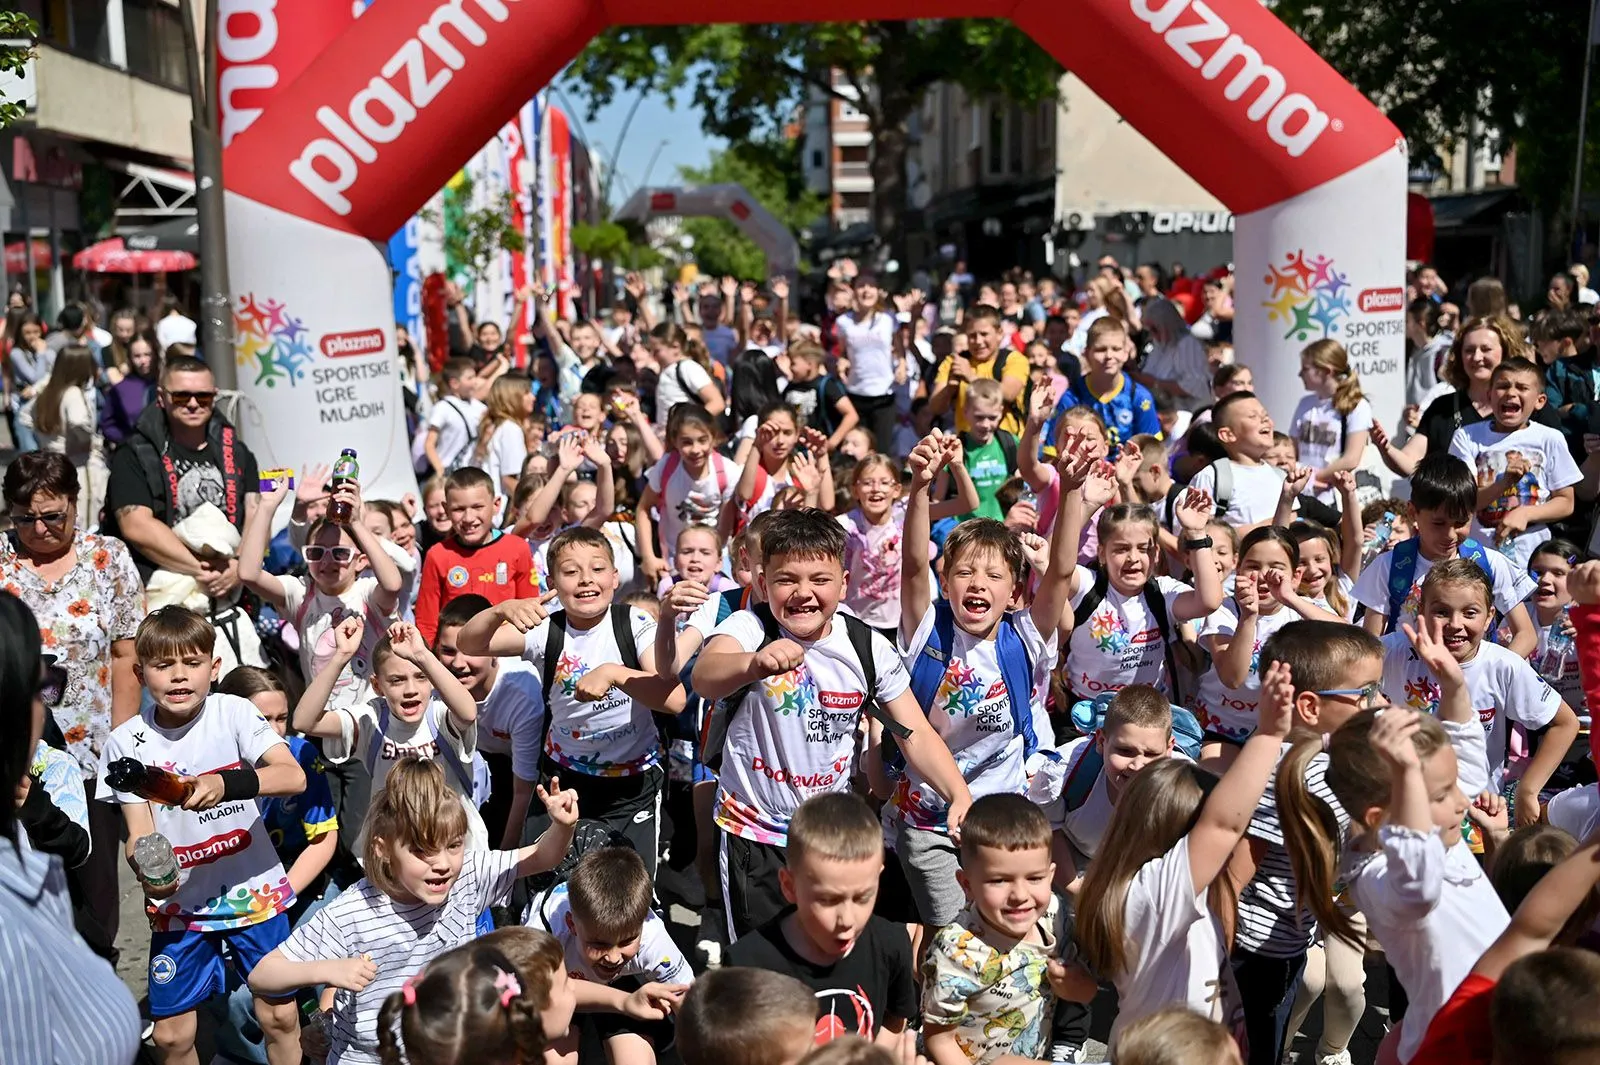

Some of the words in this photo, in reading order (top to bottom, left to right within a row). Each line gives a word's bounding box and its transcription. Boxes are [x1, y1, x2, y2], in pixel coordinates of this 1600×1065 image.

[289, 0, 521, 215] plazm
[1363, 291, 1402, 310] plazm
[326, 334, 381, 356] plazma
[1345, 341, 1379, 356] IGRE
[312, 361, 390, 384] SPORTSKE
[316, 386, 357, 403] IGRE
[320, 402, 385, 423] MLADIH
[1120, 660, 1153, 670] MLADIH
[1121, 654, 1140, 663] IGRE
[592, 697, 630, 711] MLADIH
[822, 694, 859, 706] plazma
[807, 721, 830, 733] IGRE
[977, 713, 1002, 724] IGRE
[752, 757, 833, 788] Podravka
[199, 804, 245, 824] MLADIH
[176, 835, 241, 867] plazma
